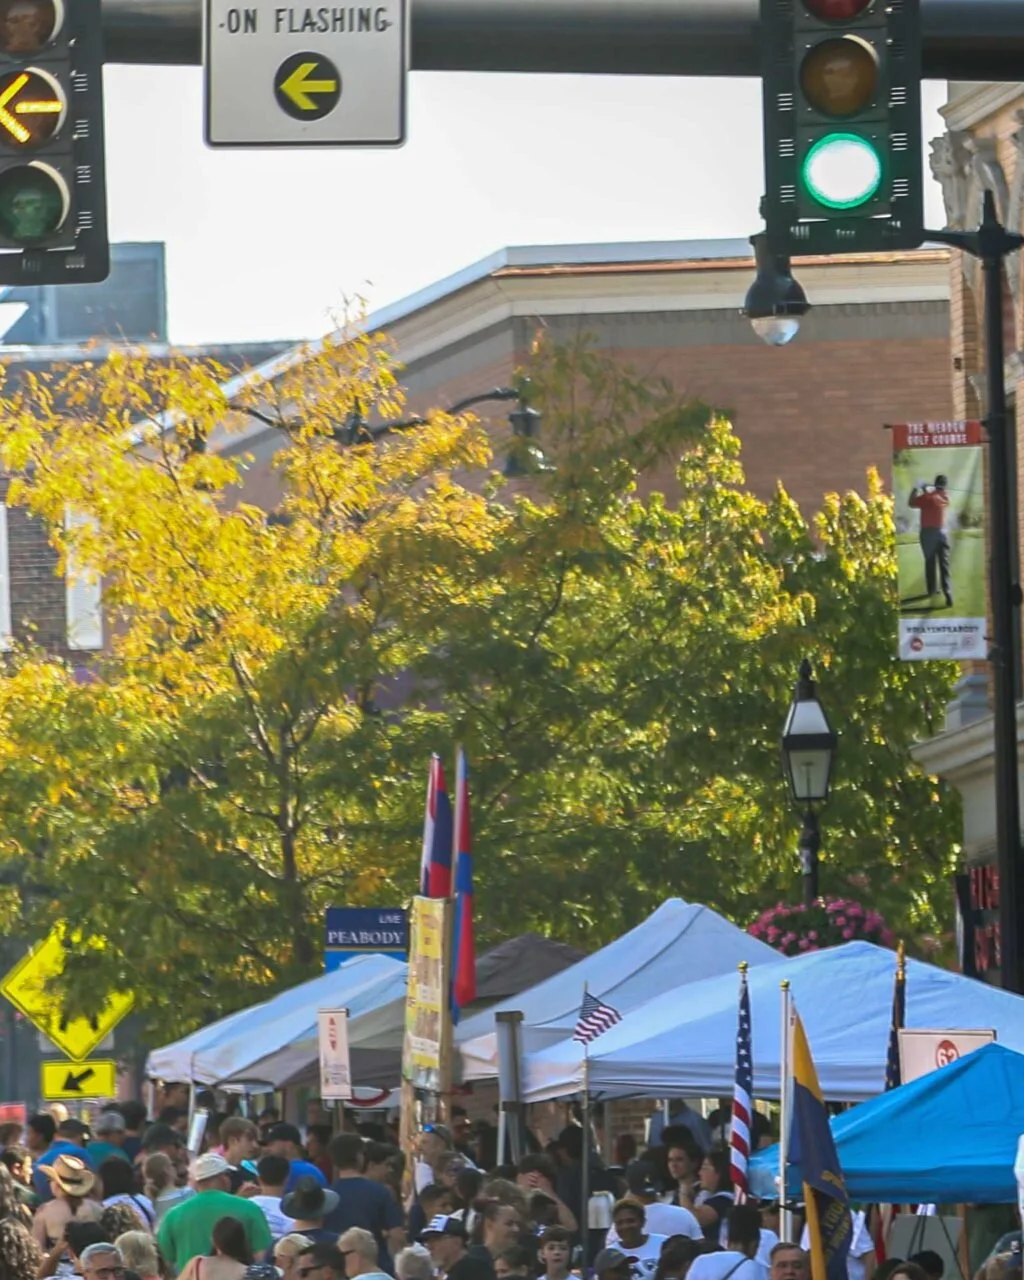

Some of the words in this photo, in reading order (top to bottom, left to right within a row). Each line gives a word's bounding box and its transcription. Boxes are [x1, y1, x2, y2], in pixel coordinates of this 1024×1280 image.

[227, 8, 257, 33] ON
[275, 7, 388, 33] FLASHING
[327, 931, 404, 944] PEABODY
